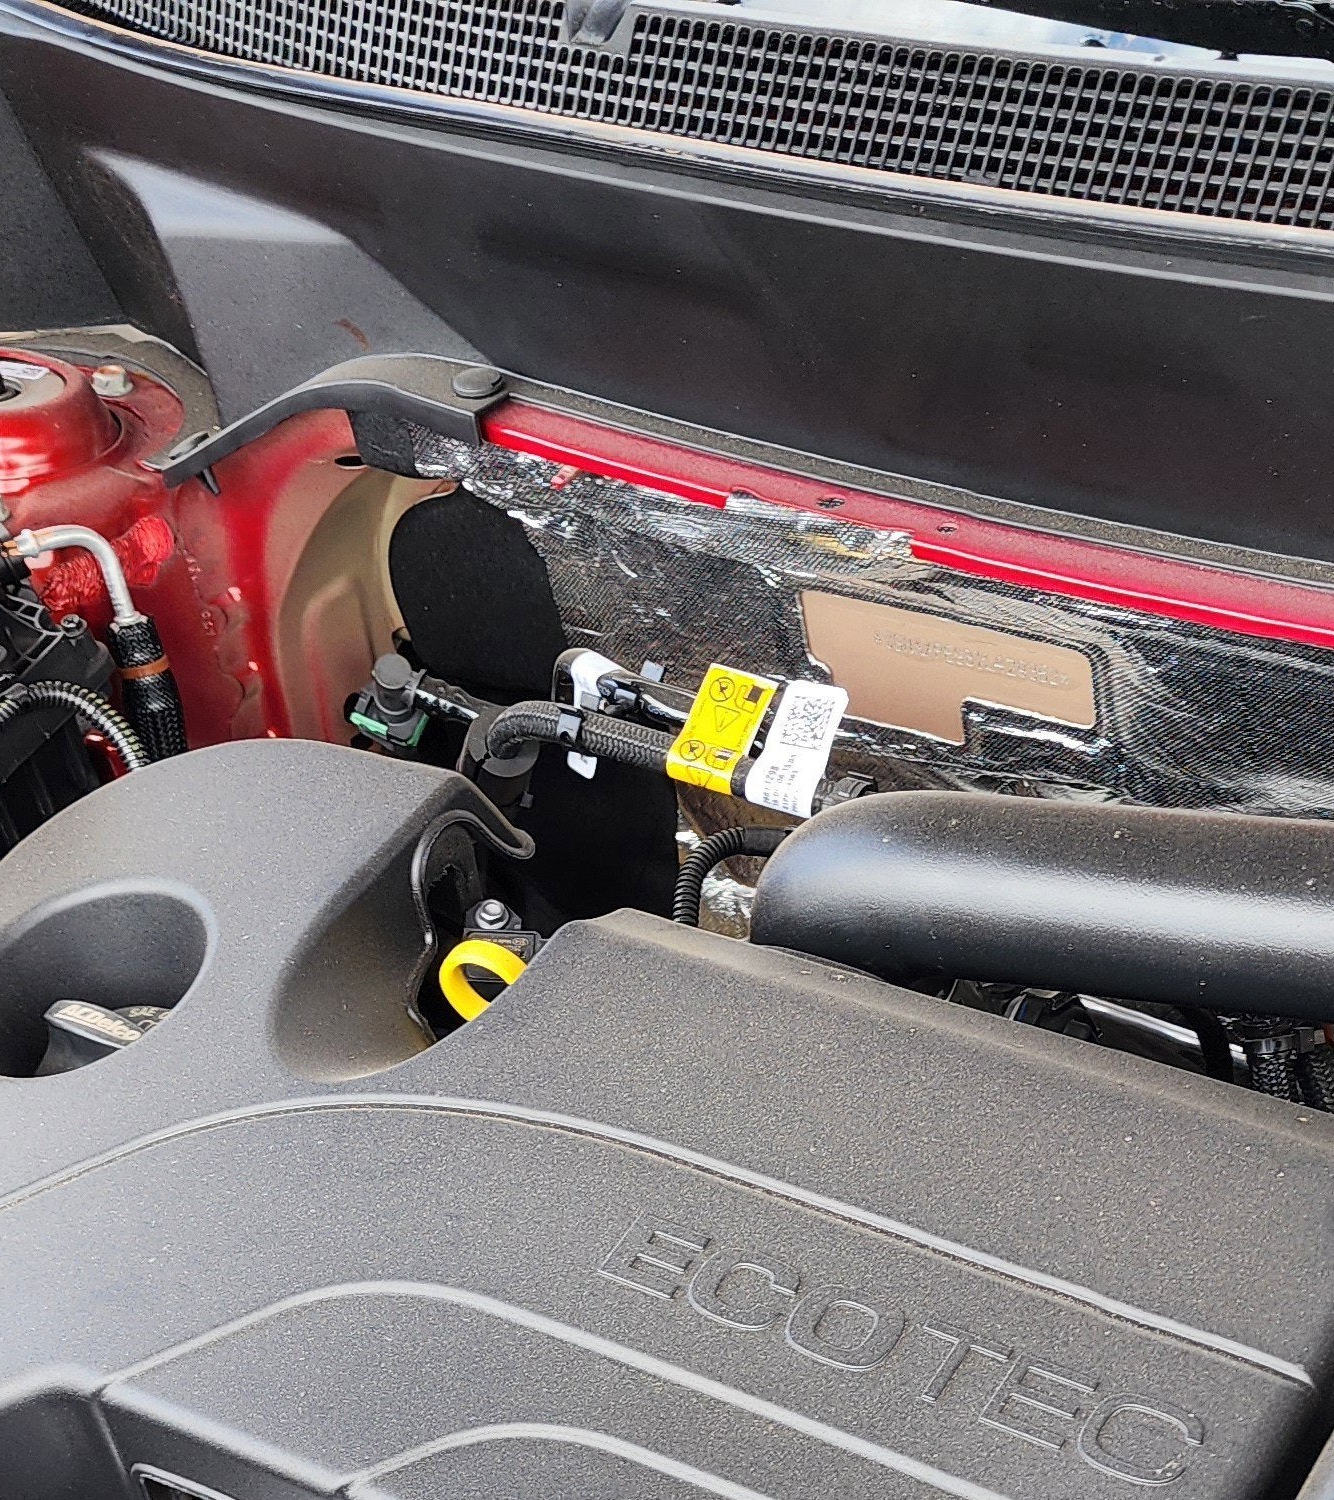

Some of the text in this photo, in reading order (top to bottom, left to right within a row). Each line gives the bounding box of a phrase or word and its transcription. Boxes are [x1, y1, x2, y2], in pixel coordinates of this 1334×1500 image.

[57, 1004, 141, 1040] ACDelco
[129, 1007, 157, 1018] SAE
[598, 1212, 1204, 1486] ECOTEC
